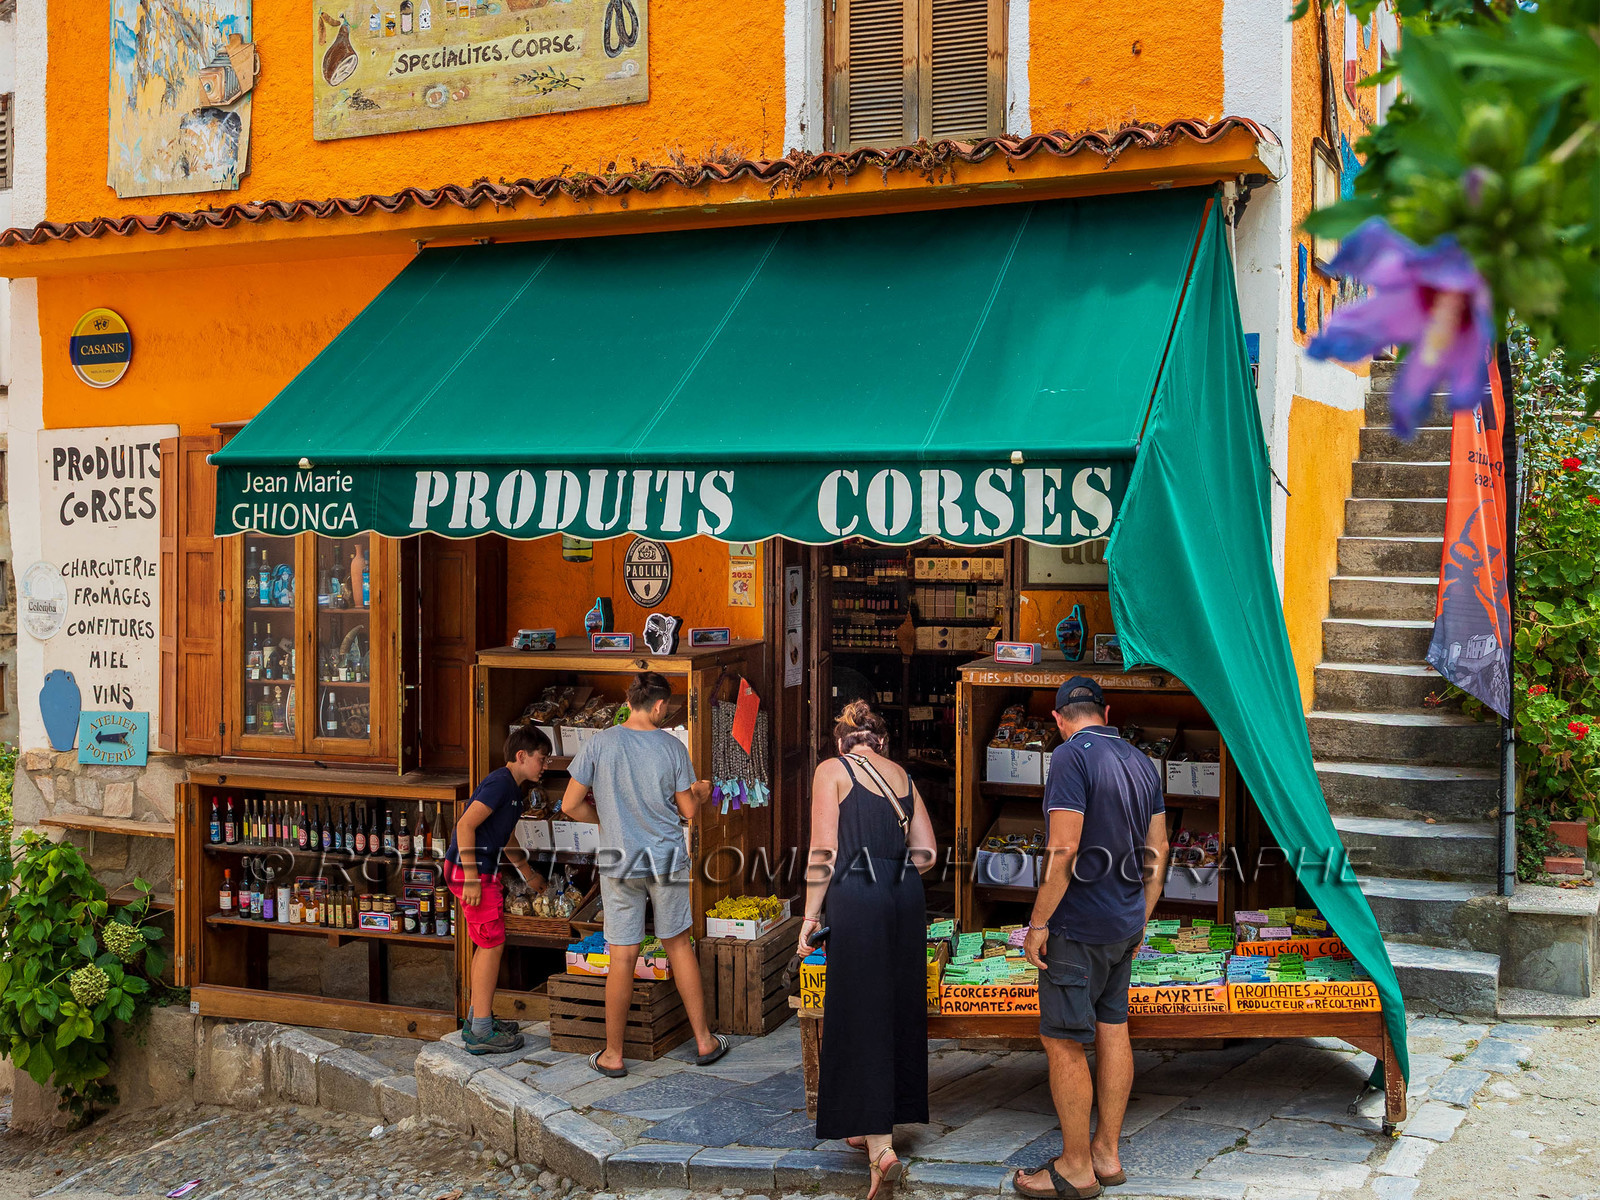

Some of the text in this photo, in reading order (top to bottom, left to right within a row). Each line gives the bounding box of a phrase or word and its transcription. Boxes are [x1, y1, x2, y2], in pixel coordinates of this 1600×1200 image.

[80, 343, 125, 356] CASANIS
[52, 443, 160, 481] PRODUITS
[242, 469, 353, 493] Jean Marie
[60, 487, 157, 526] CORSES
[409, 467, 1113, 538] PRODUITS CORSES
[232, 502, 359, 531] GHIONGA
[61, 556, 157, 580] CHARCUTERIE
[626, 565, 668, 577] PAOLINA
[74, 587, 151, 608] FROMAGES
[67, 617, 155, 640] CONFITURES
[89, 651, 129, 668] MIEL
[1013, 671, 1066, 686] ROOIBOS
[93, 683, 134, 710] VINS
[88, 715, 138, 734] ATELIER
[86, 742, 136, 763] POTERIE
[1131, 988, 1216, 1003] de MYRTE
[1234, 984, 1311, 998] AROMATES
[1237, 999, 1304, 1010] PRODUCTEUR
[1315, 997, 1377, 1009] RÉCOLTANT
